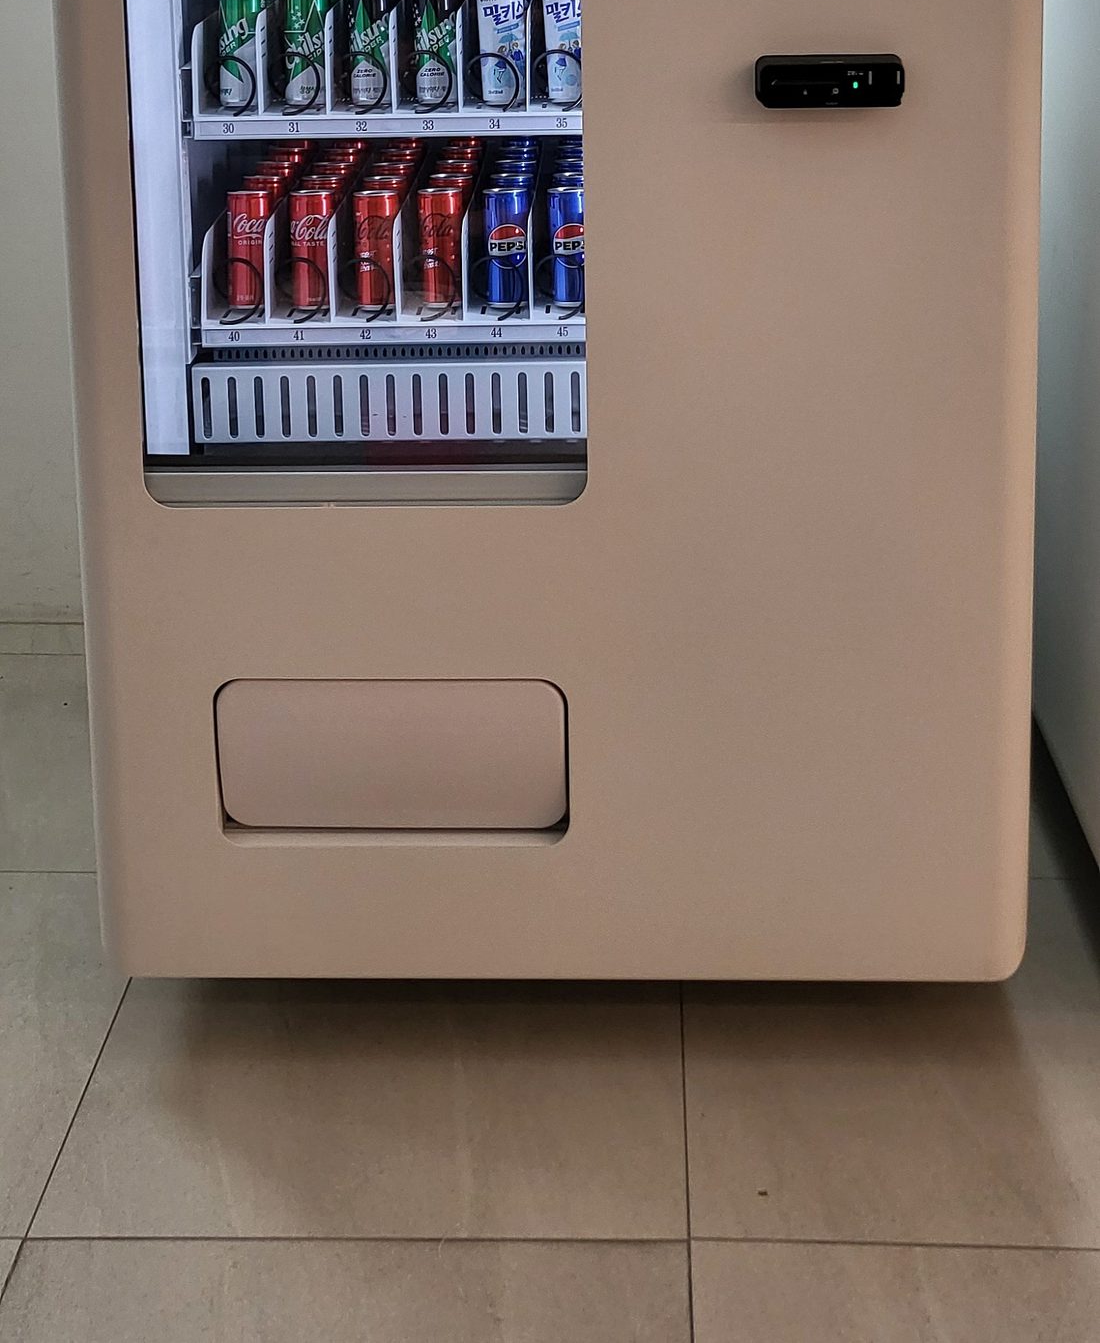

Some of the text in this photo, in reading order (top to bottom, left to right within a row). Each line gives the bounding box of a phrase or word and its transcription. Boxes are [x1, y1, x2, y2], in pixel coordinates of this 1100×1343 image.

[288, 122, 299, 133] 31
[356, 121, 367, 132] 32
[422, 120, 434, 131] 33
[489, 118, 500, 129] 34
[556, 117, 567, 128] 35
[222, 123, 234, 134] 30
[233, 213, 266, 233] Coca
[228, 331, 240, 341] 40
[293, 330, 304, 341] 41
[359, 329, 371, 340] 42
[425, 328, 437, 339] 43
[490, 327, 502, 338] 44
[556, 326, 569, 337] 45
